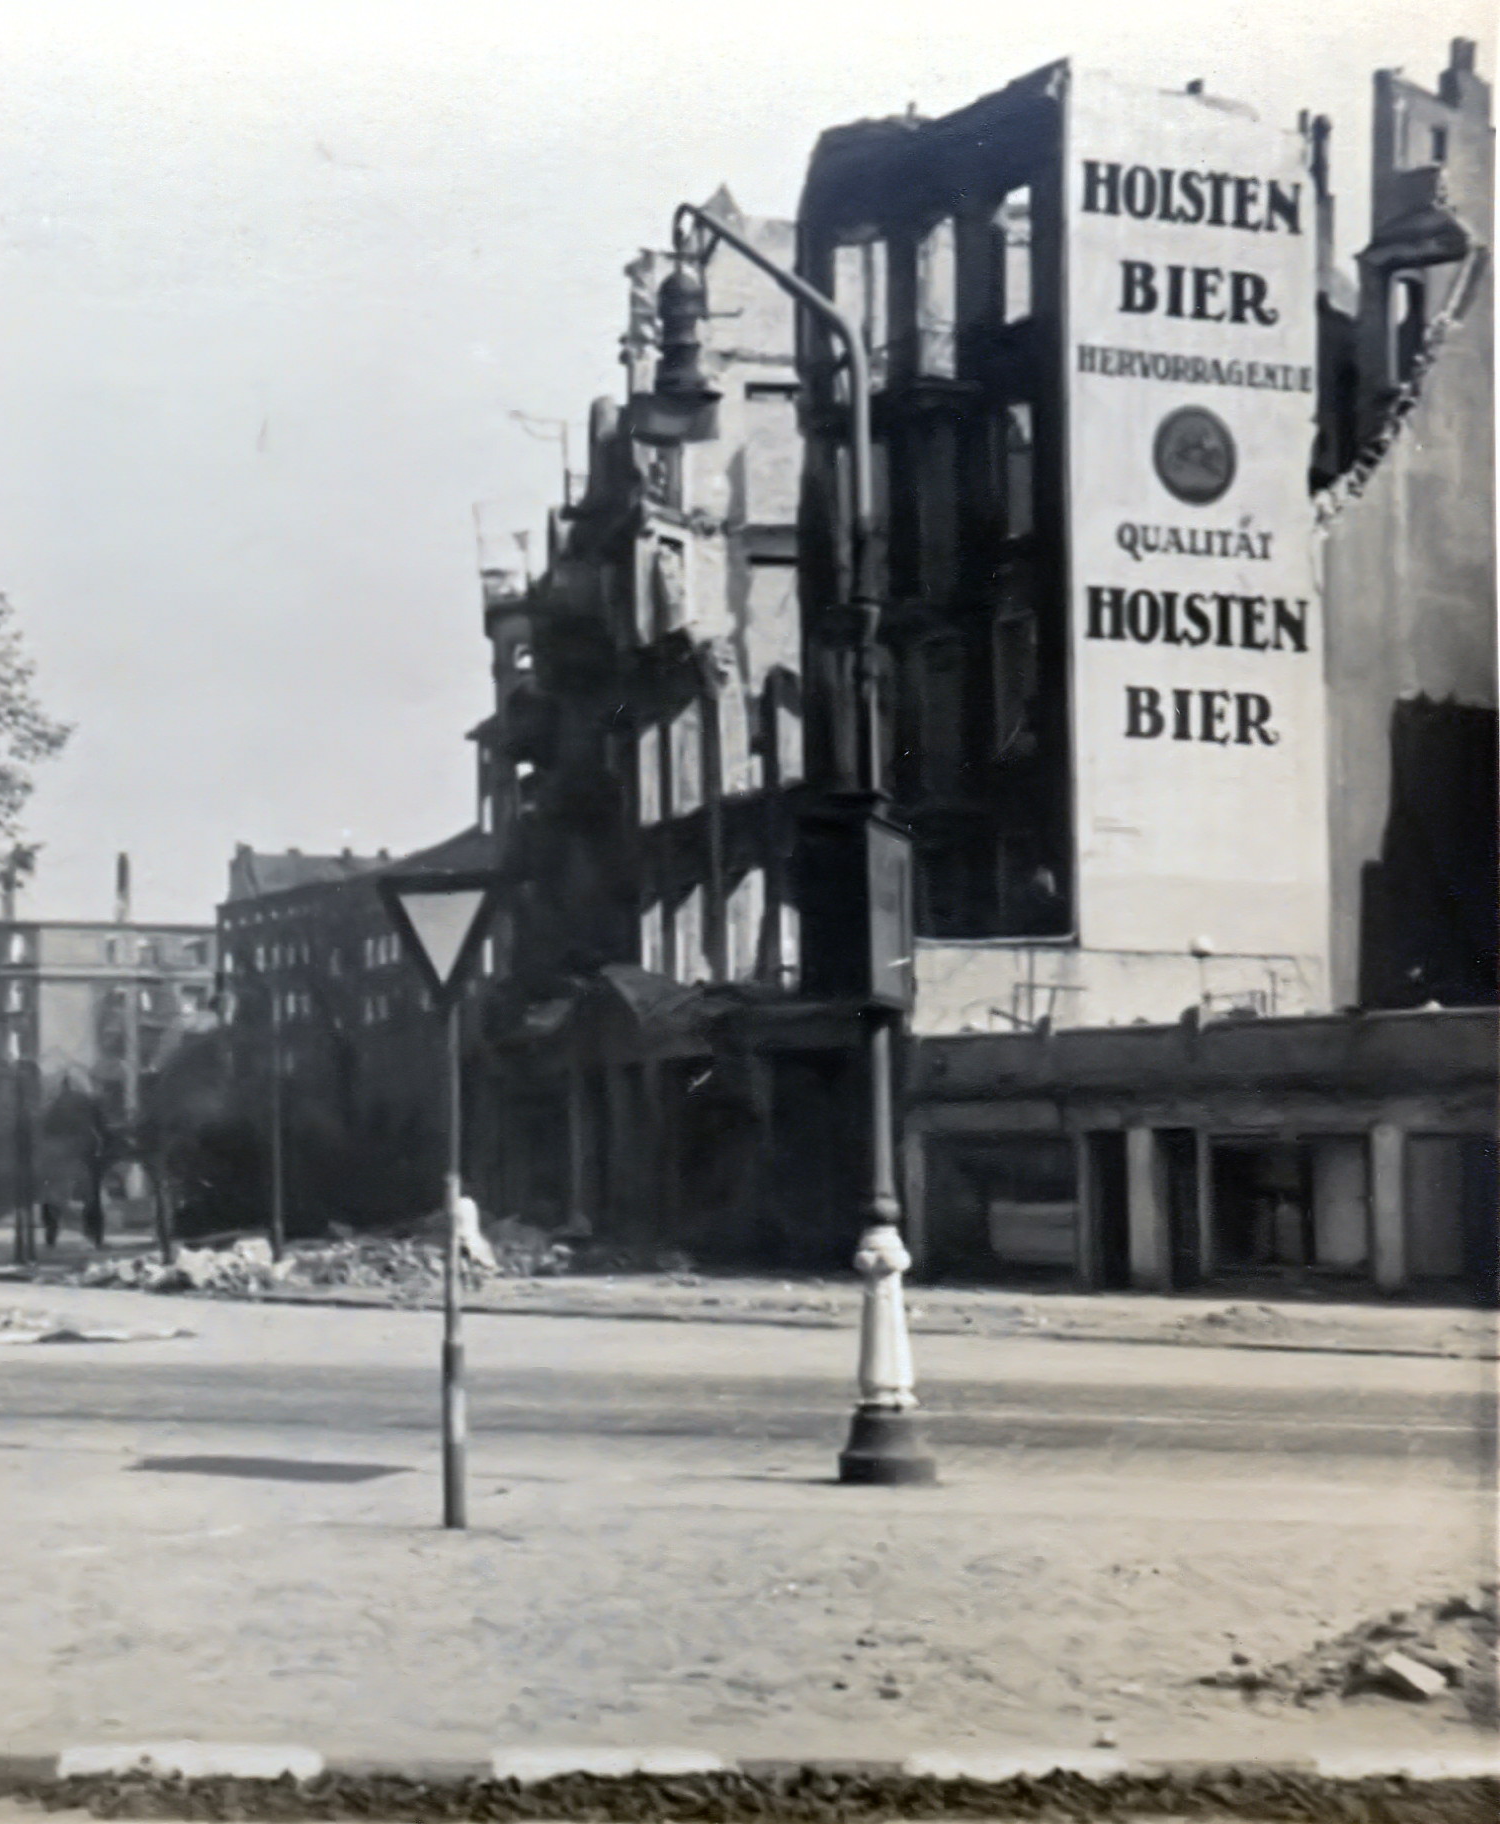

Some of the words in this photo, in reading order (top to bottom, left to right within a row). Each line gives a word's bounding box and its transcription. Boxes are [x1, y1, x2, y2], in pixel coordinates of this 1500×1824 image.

[1082, 160, 1303, 235] HOLSTEN
[1119, 259, 1279, 327] BIER
[1086, 585, 1309, 653] HOLSTEN
[1124, 685, 1280, 746] BIER
